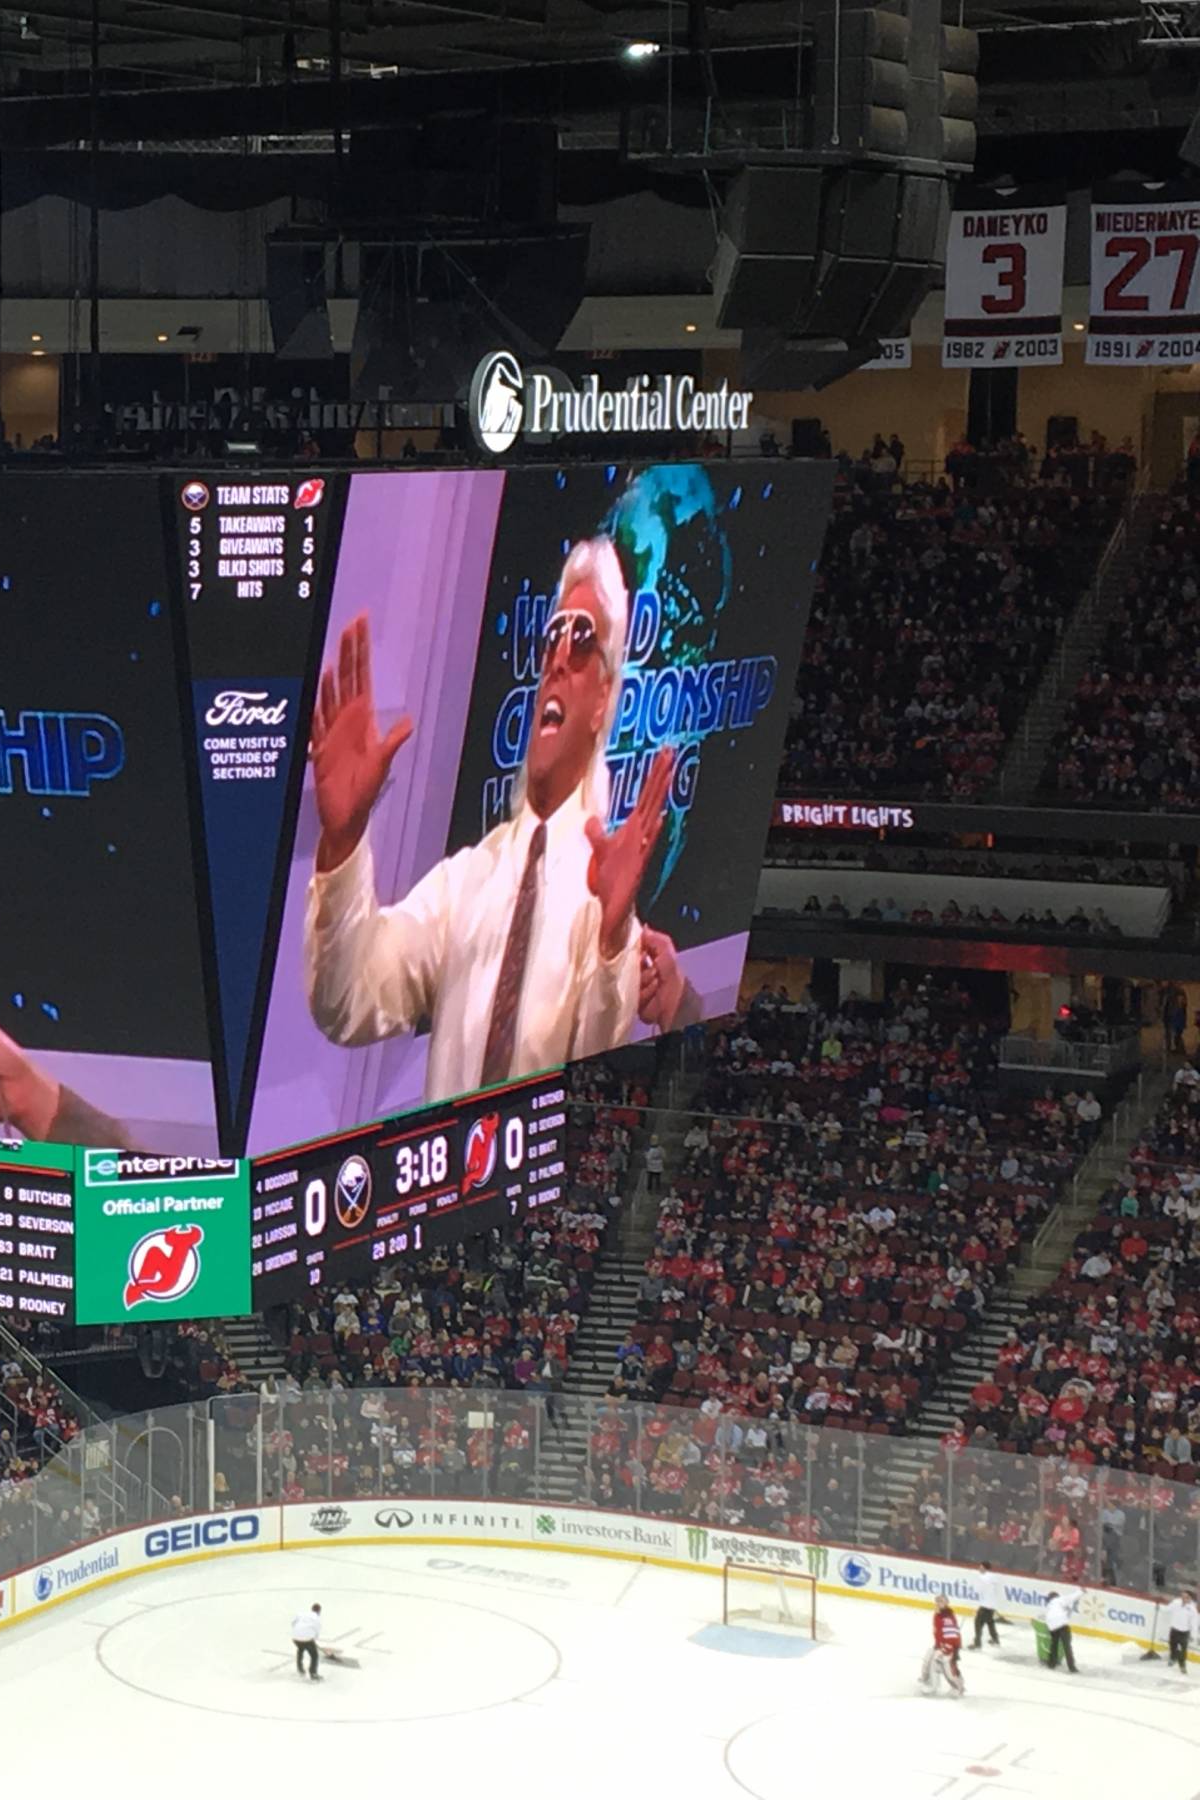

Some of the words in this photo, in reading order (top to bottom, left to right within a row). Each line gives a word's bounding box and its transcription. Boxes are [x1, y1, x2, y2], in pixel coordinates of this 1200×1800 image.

[963, 214, 1048, 238] DANEYKO
[981, 243, 1027, 314] 3
[1104, 234, 1199, 311] 27
[946, 342, 985, 359] 1982
[1015, 339, 1059, 357] 2003
[1095, 341, 1131, 357] 1991
[531, 374, 672, 433] Prudential
[676, 374, 753, 430] Center
[216, 486, 250, 505] TEAM
[253, 486, 290, 504] STATS
[190, 517, 201, 534] 5
[219, 516, 285, 533] TAKEAWAYS
[304, 515, 314, 532] 1
[189, 540, 200, 556] 3
[220, 538, 283, 555] GIVEAWAYS
[303, 538, 314, 554] 5
[189, 561, 200, 577] 3
[218, 560, 247, 577] BLKD
[249, 559, 284, 576] SHOTS
[301, 559, 314, 575] 4
[190, 583, 201, 600] 7
[237, 581, 263, 598] HITS
[299, 581, 310, 598] 8
[205, 690, 288, 726] Ford
[492, 655, 778, 769] CPIONSHIP
[204, 738, 237, 750] COME
[239, 737, 268, 749] VISIT
[270, 736, 287, 748] US
[211, 752, 261, 764] OUTSIDE
[262, 751, 279, 763] OF
[213, 767, 262, 779] SECTION
[264, 766, 276, 778] 21
[782, 804, 847, 826] BRIGHT
[851, 806, 914, 828] LIGHTS
[505, 1117, 523, 1170] 0
[97, 1156, 233, 1176] enterprise
[396, 1135, 448, 1194] 3:18
[18, 1188, 72, 1208] BUTCHER
[102, 1197, 160, 1216] Official
[164, 1196, 224, 1213] Partner
[305, 1178, 326, 1236] 0
[510, 1201, 517, 1216] 7
[18, 1215, 74, 1234] SEVERSON
[414, 1224, 421, 1250] 1
[19, 1242, 56, 1260] BRATT
[0, 1267, 13, 1281] 21
[19, 1269, 73, 1289] PALMIERI
[19, 1296, 66, 1315] ROONEY
[422, 1513, 522, 1529] INFINITI
[144, 1514, 259, 1557] GEICO
[561, 1519, 673, 1548] investorsBank
[57, 1547, 119, 1589] Prudential
[878, 1566, 979, 1601] Prudentia
